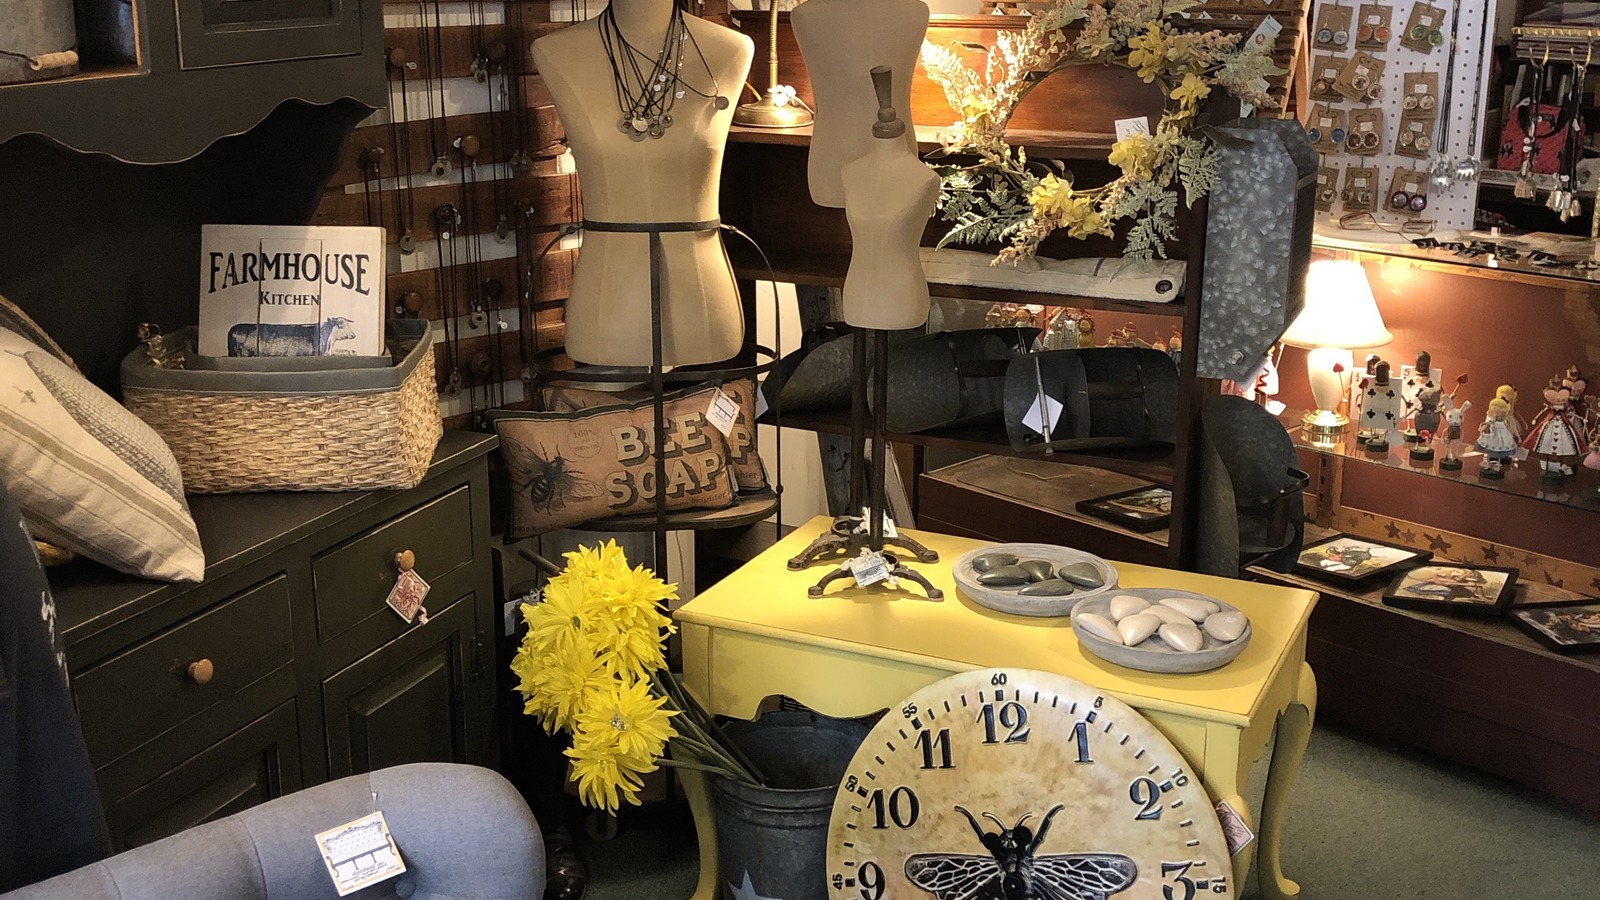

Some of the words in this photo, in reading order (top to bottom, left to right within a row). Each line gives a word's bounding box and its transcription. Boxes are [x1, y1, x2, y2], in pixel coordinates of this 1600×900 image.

[208, 252, 370, 296] FARMHOUSE
[260, 291, 320, 306] KITCHEN
[611, 411, 711, 466] BEE
[605, 453, 722, 508] SOAP
[991, 673, 1007, 686] 60
[902, 702, 918, 719] 55
[976, 702, 1032, 744] 12
[914, 728, 956, 769] 11
[1068, 720, 1095, 764] 1
[845, 775, 858, 793] 50
[1171, 767, 1189, 787] 10
[867, 786, 920, 830] 10
[1129, 777, 1163, 821] 2
[832, 873, 843, 891] 45
[858, 861, 886, 900] 9
[1161, 861, 1196, 900] 3
[1211, 876, 1227, 894] 15
